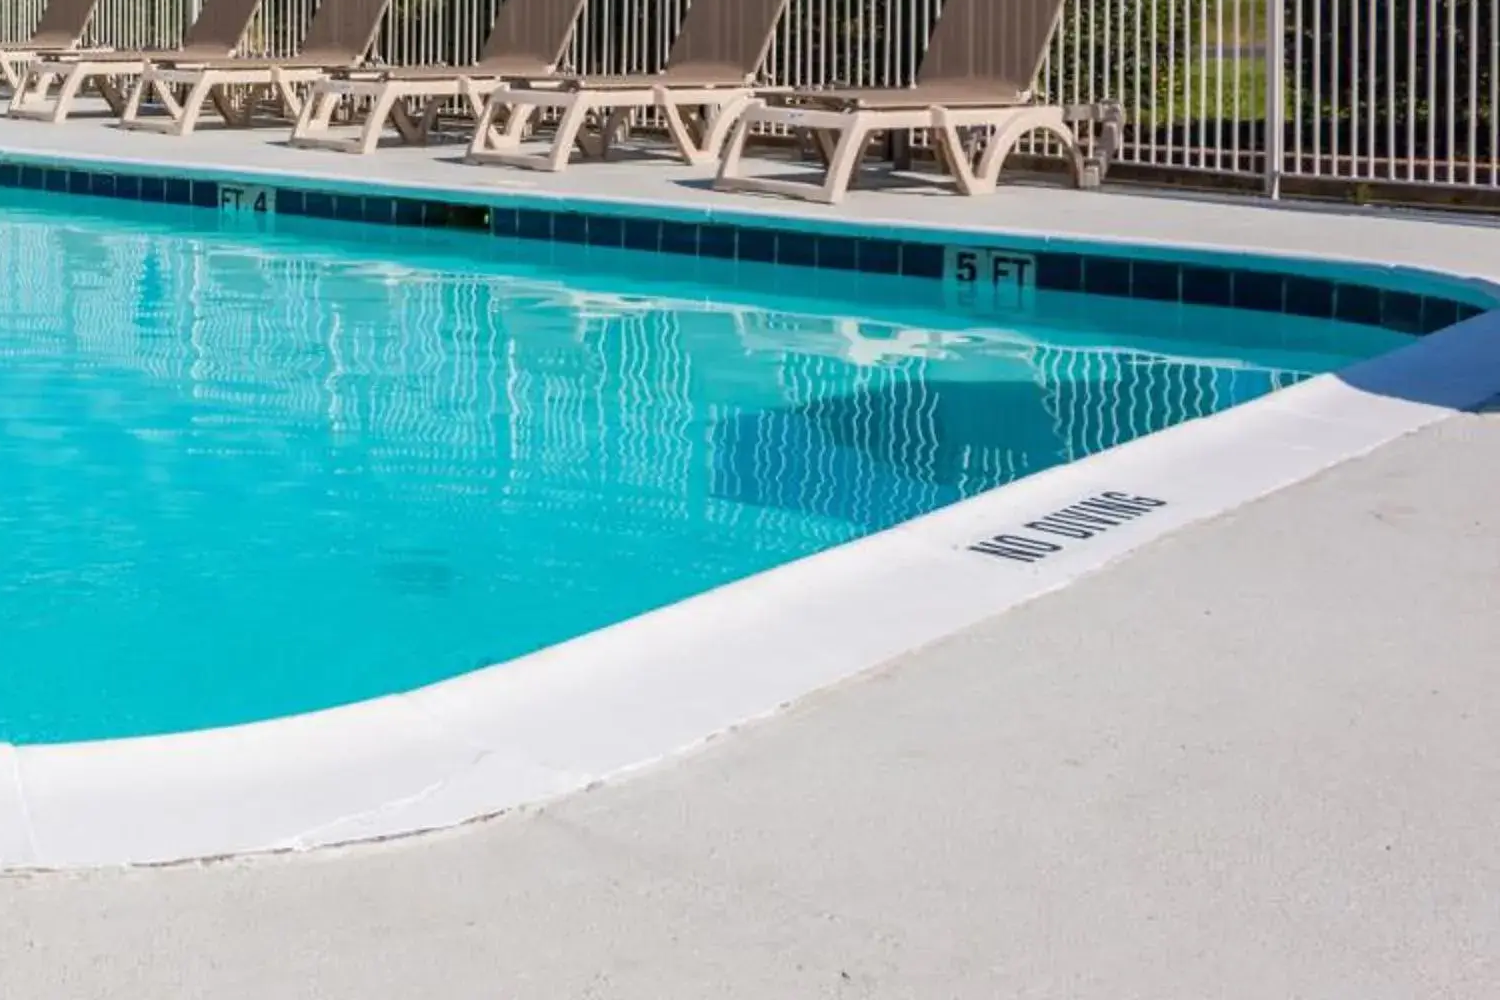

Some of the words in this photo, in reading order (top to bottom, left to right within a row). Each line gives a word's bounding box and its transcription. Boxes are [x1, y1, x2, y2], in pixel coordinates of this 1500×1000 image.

[222, 187, 244, 211] FT
[253, 190, 267, 212] 4
[956, 251, 978, 281] 5
[993, 257, 1031, 287] FT
[967, 534, 1063, 564] NO
[1023, 490, 1168, 540] DIVING
